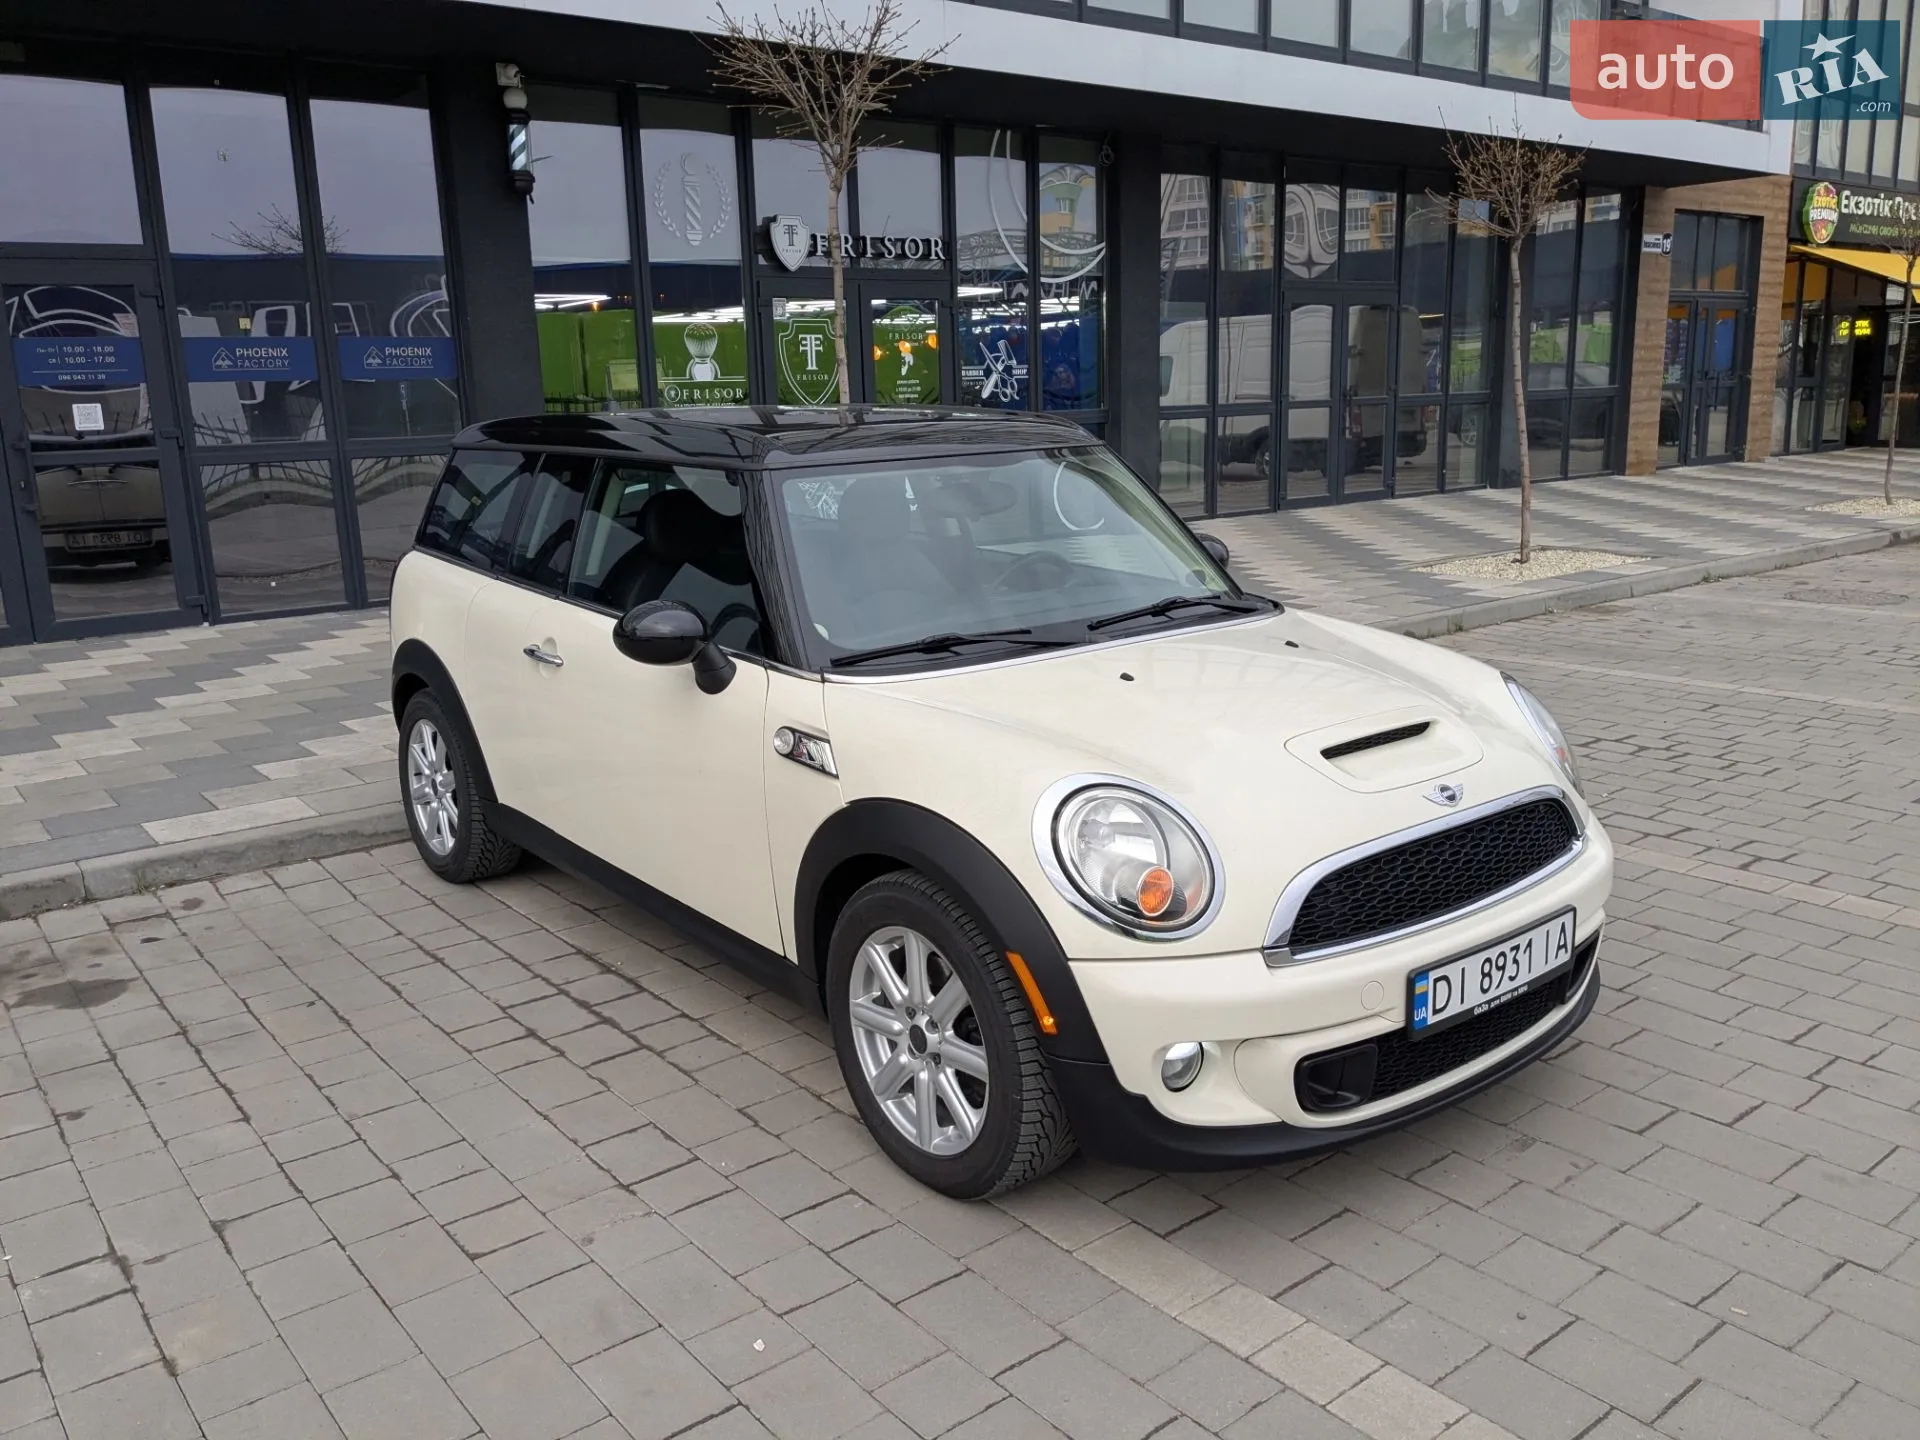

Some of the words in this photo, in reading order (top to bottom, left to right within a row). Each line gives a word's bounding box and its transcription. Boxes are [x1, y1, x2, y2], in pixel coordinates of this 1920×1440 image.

[1841, 190, 1893, 217] Екзотік
[1810, 208, 1838, 222] PREMIUM
[815, 233, 945, 260] FRISOR
[236, 347, 288, 357] PHOENIX
[385, 346, 432, 356] PHOENIX
[237, 359, 289, 368] FACTORY
[385, 357, 433, 366] FACTORY
[683, 387, 744, 400] FRISOR
[1432, 967, 1465, 1016] DI
[1480, 937, 1533, 994] 8931
[1545, 921, 1568, 966] IA
[1414, 1009, 1427, 1021] UA
